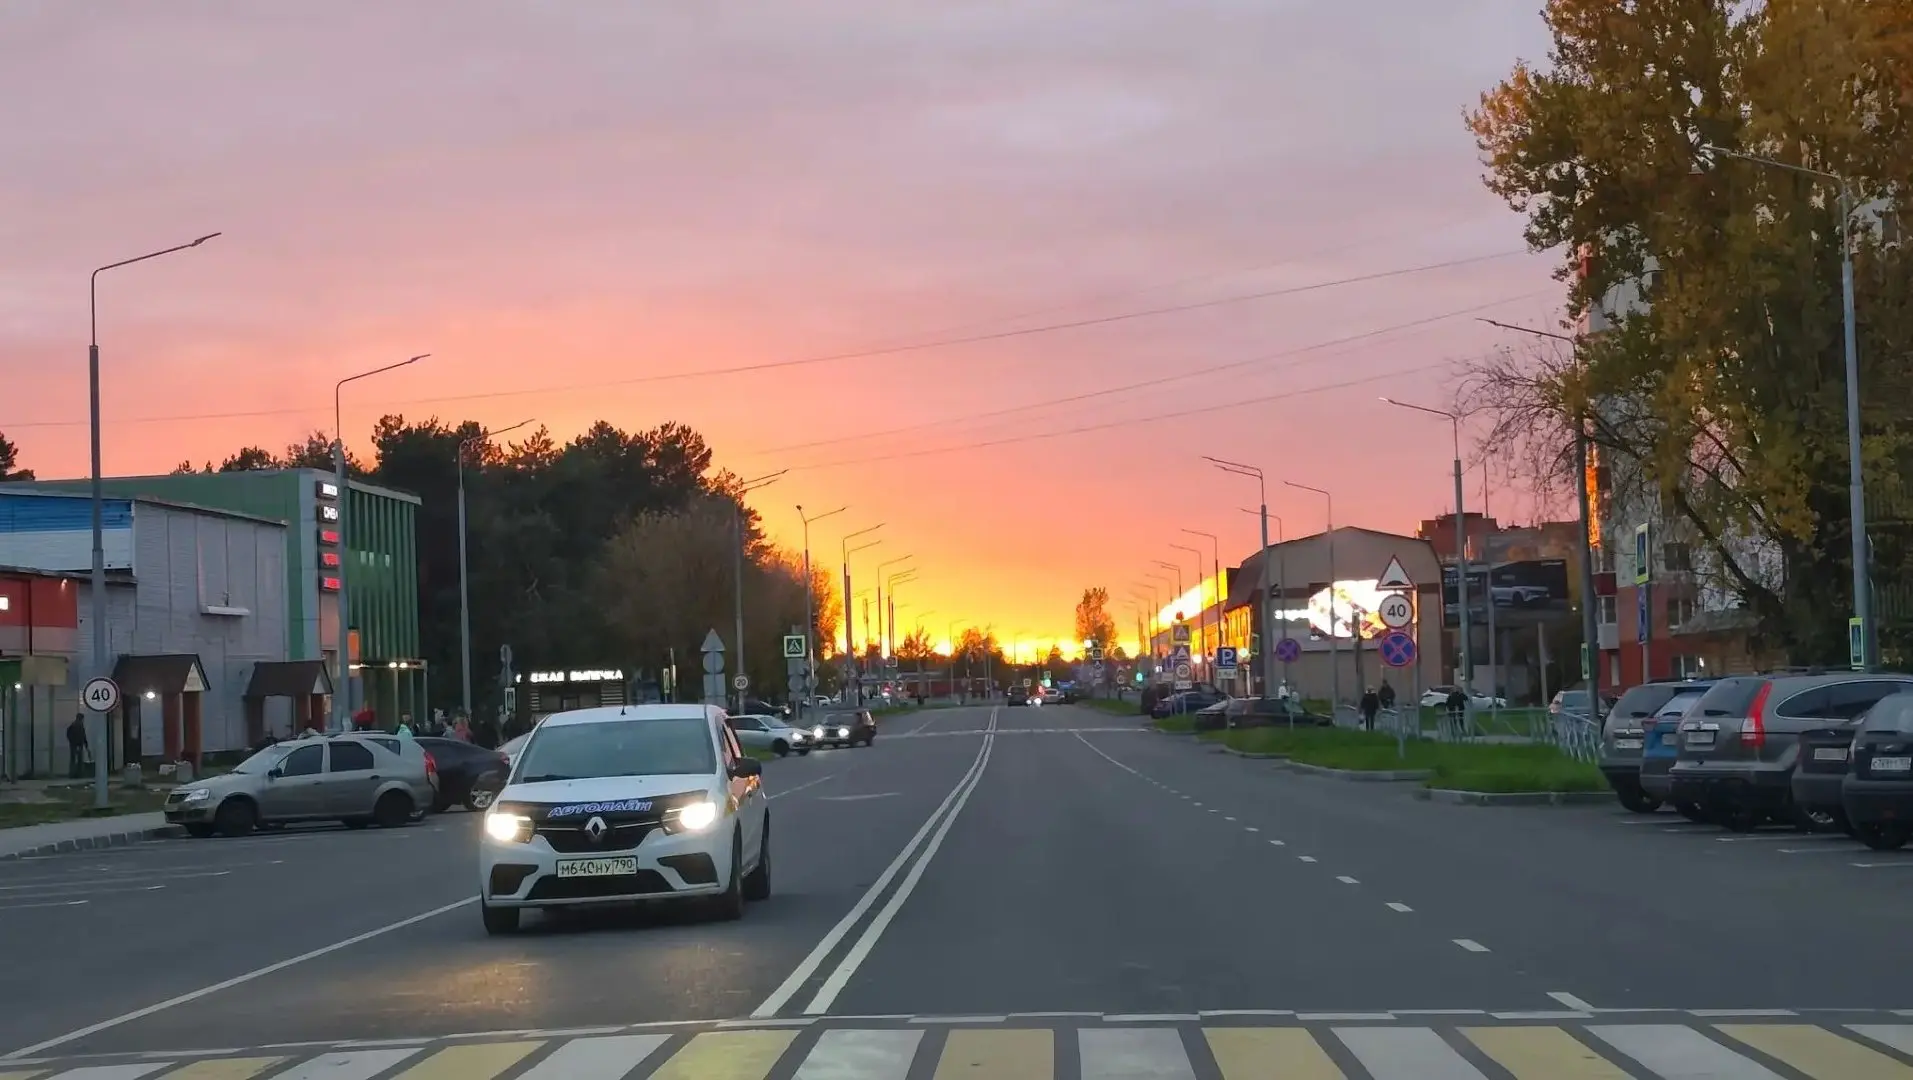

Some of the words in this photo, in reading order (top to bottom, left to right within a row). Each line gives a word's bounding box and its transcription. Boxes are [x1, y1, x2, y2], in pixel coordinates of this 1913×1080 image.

[1387, 604, 1406, 617] 40
[91, 688, 110, 702] 40
[547, 800, 652, 817] АВТОЛАЙН
